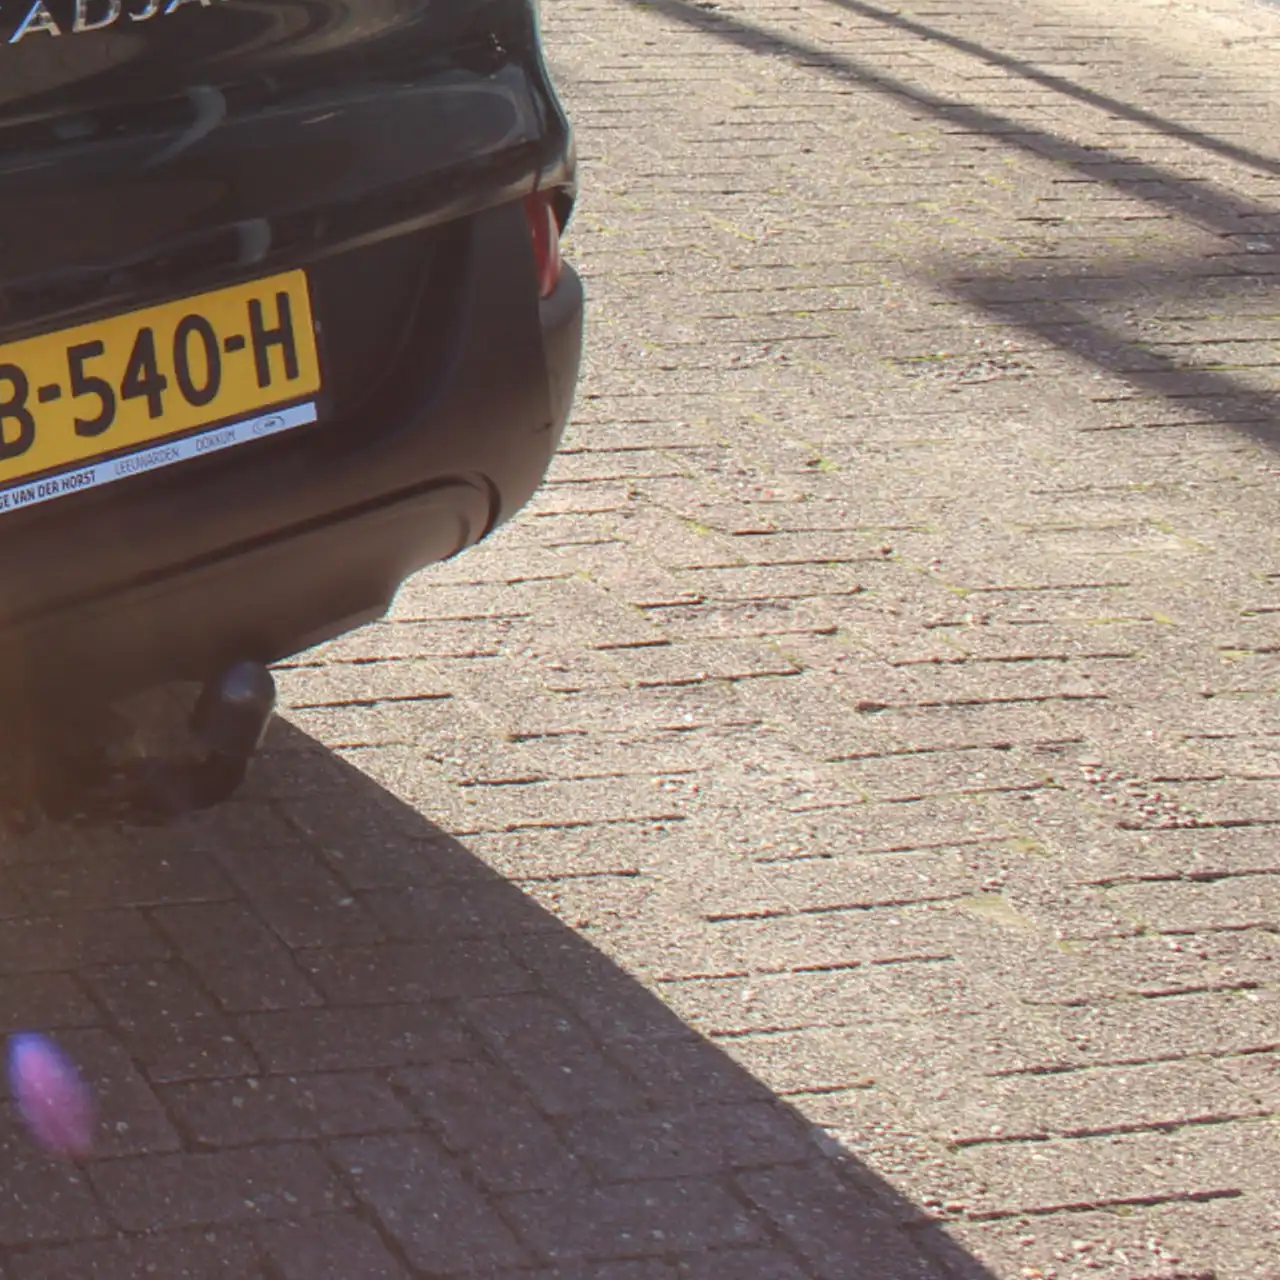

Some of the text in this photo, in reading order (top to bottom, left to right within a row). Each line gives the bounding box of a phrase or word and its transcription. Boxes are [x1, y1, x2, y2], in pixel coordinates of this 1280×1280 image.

[12, 489, 35, 506] VAN
[38, 481, 59, 498] DER
[62, 470, 96, 491] HORST
[113, 446, 180, 476] LEEUWARDEN
[195, 429, 237, 453] DOKKUM
